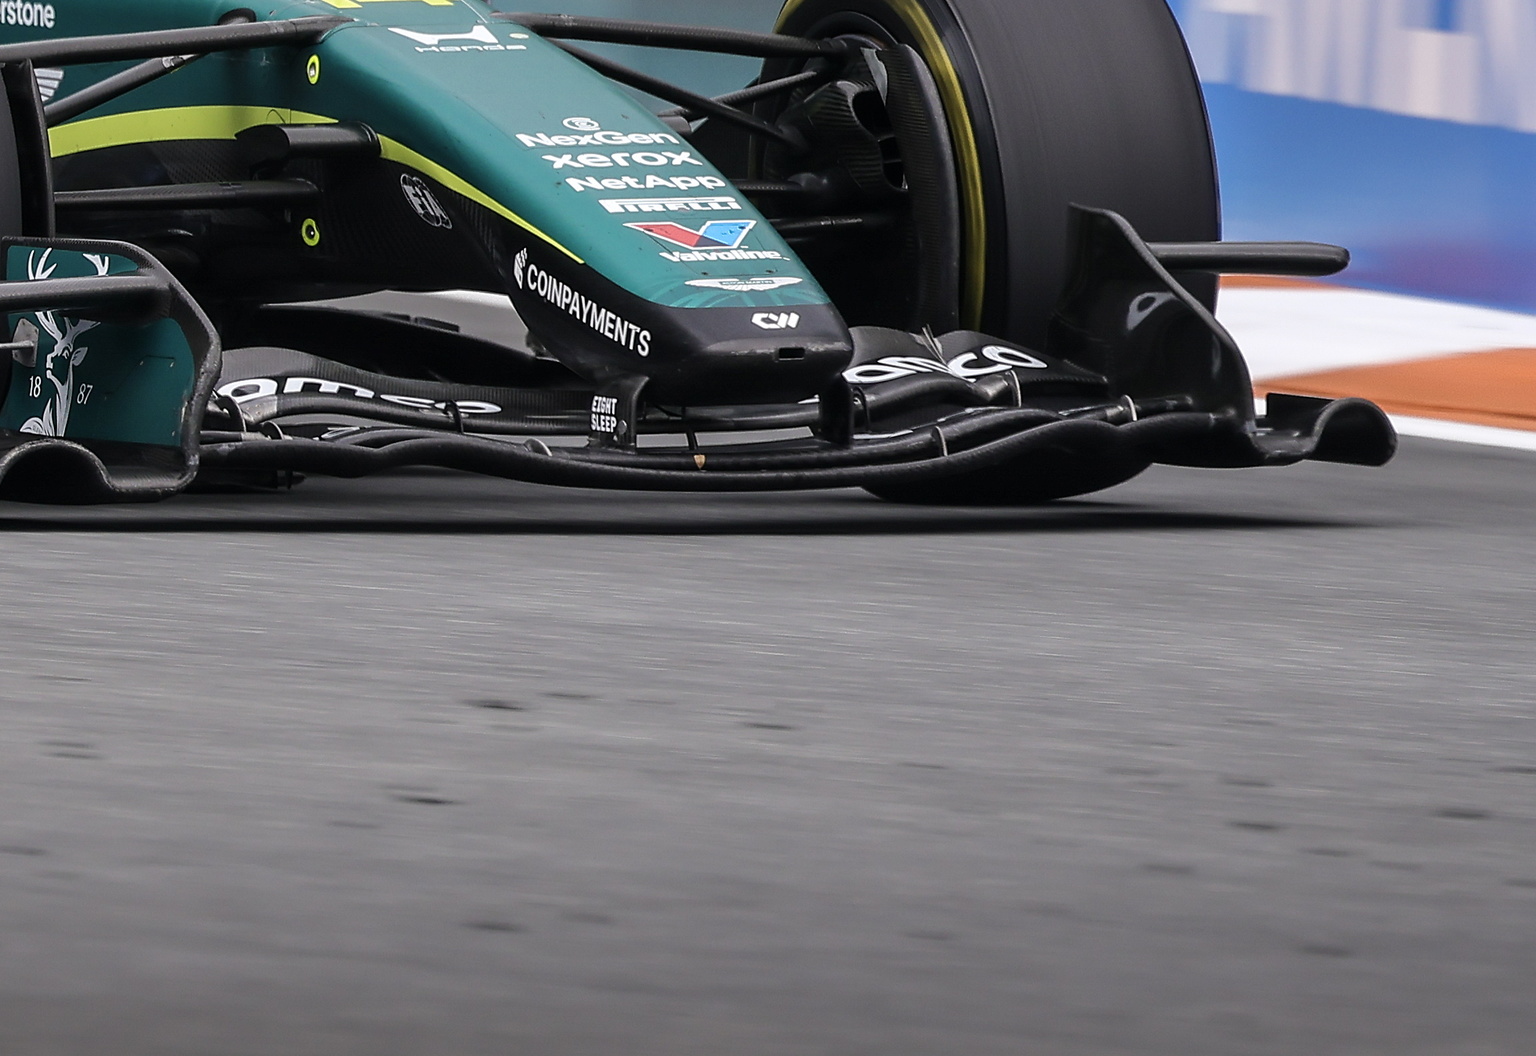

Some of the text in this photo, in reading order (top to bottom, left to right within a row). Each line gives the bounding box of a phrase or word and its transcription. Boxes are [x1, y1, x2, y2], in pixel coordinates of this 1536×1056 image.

[515, 130, 680, 148] NexGen
[541, 151, 703, 169] xerox
[565, 174, 726, 192] NetApp
[598, 196, 742, 214] PIRELLI
[527, 263, 651, 357] COINPAYMENTS
[841, 345, 1049, 384] amco
[28, 375, 93, 405] 18 87
[216, 377, 503, 414] amco
[591, 395, 618, 415] EIGHT
[590, 413, 617, 433] SLEEP
